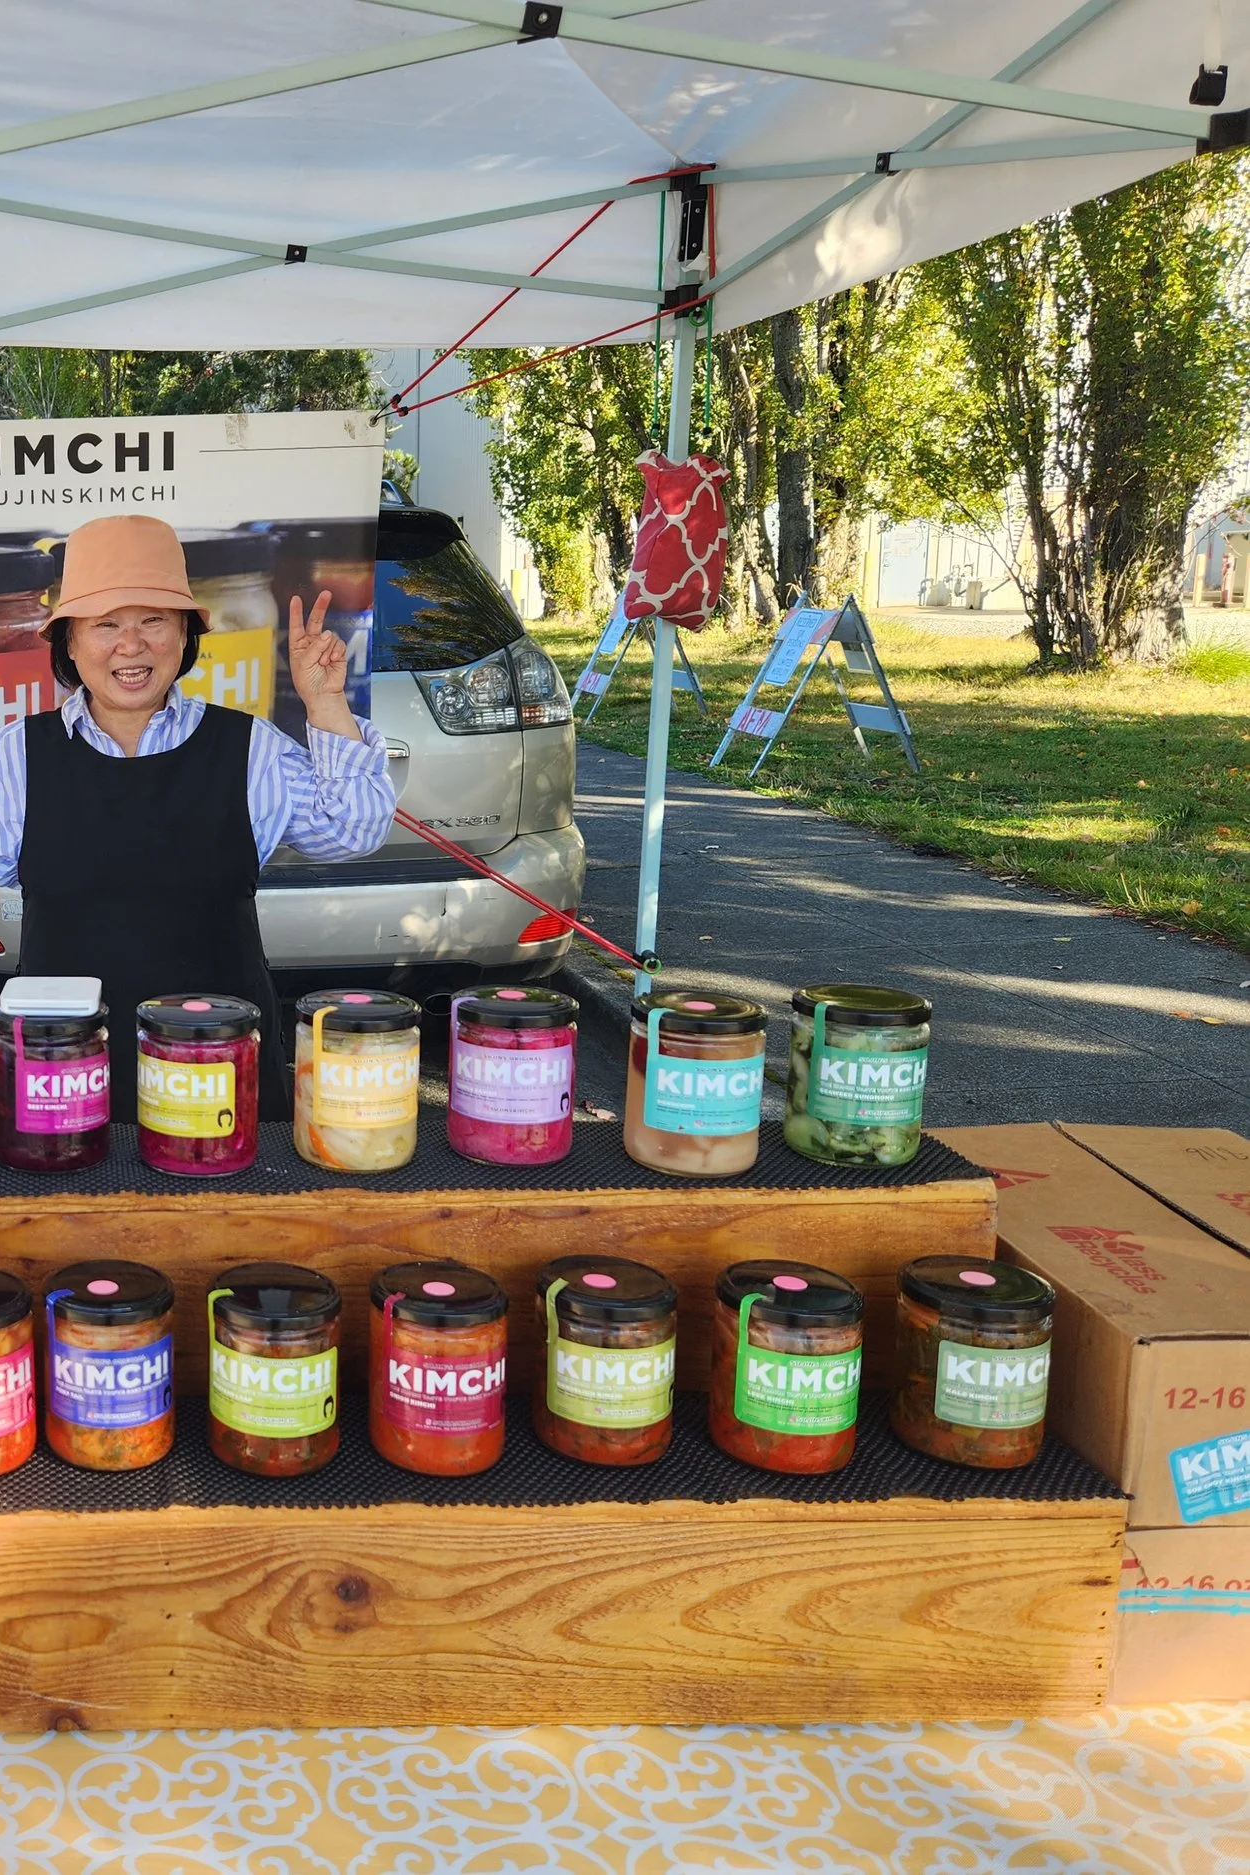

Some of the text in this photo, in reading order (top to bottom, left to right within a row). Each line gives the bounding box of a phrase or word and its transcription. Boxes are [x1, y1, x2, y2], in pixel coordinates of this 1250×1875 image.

[456, 1052, 568, 1086] KIMCHI
[54, 1350, 169, 1390] KIMCHI
[213, 1349, 331, 1393] KIMCHI
[389, 1356, 506, 1397] KIMCHI
[968, 1391, 999, 1401] KIMCHI
[1163, 1386, 1247, 1410] 12-16
